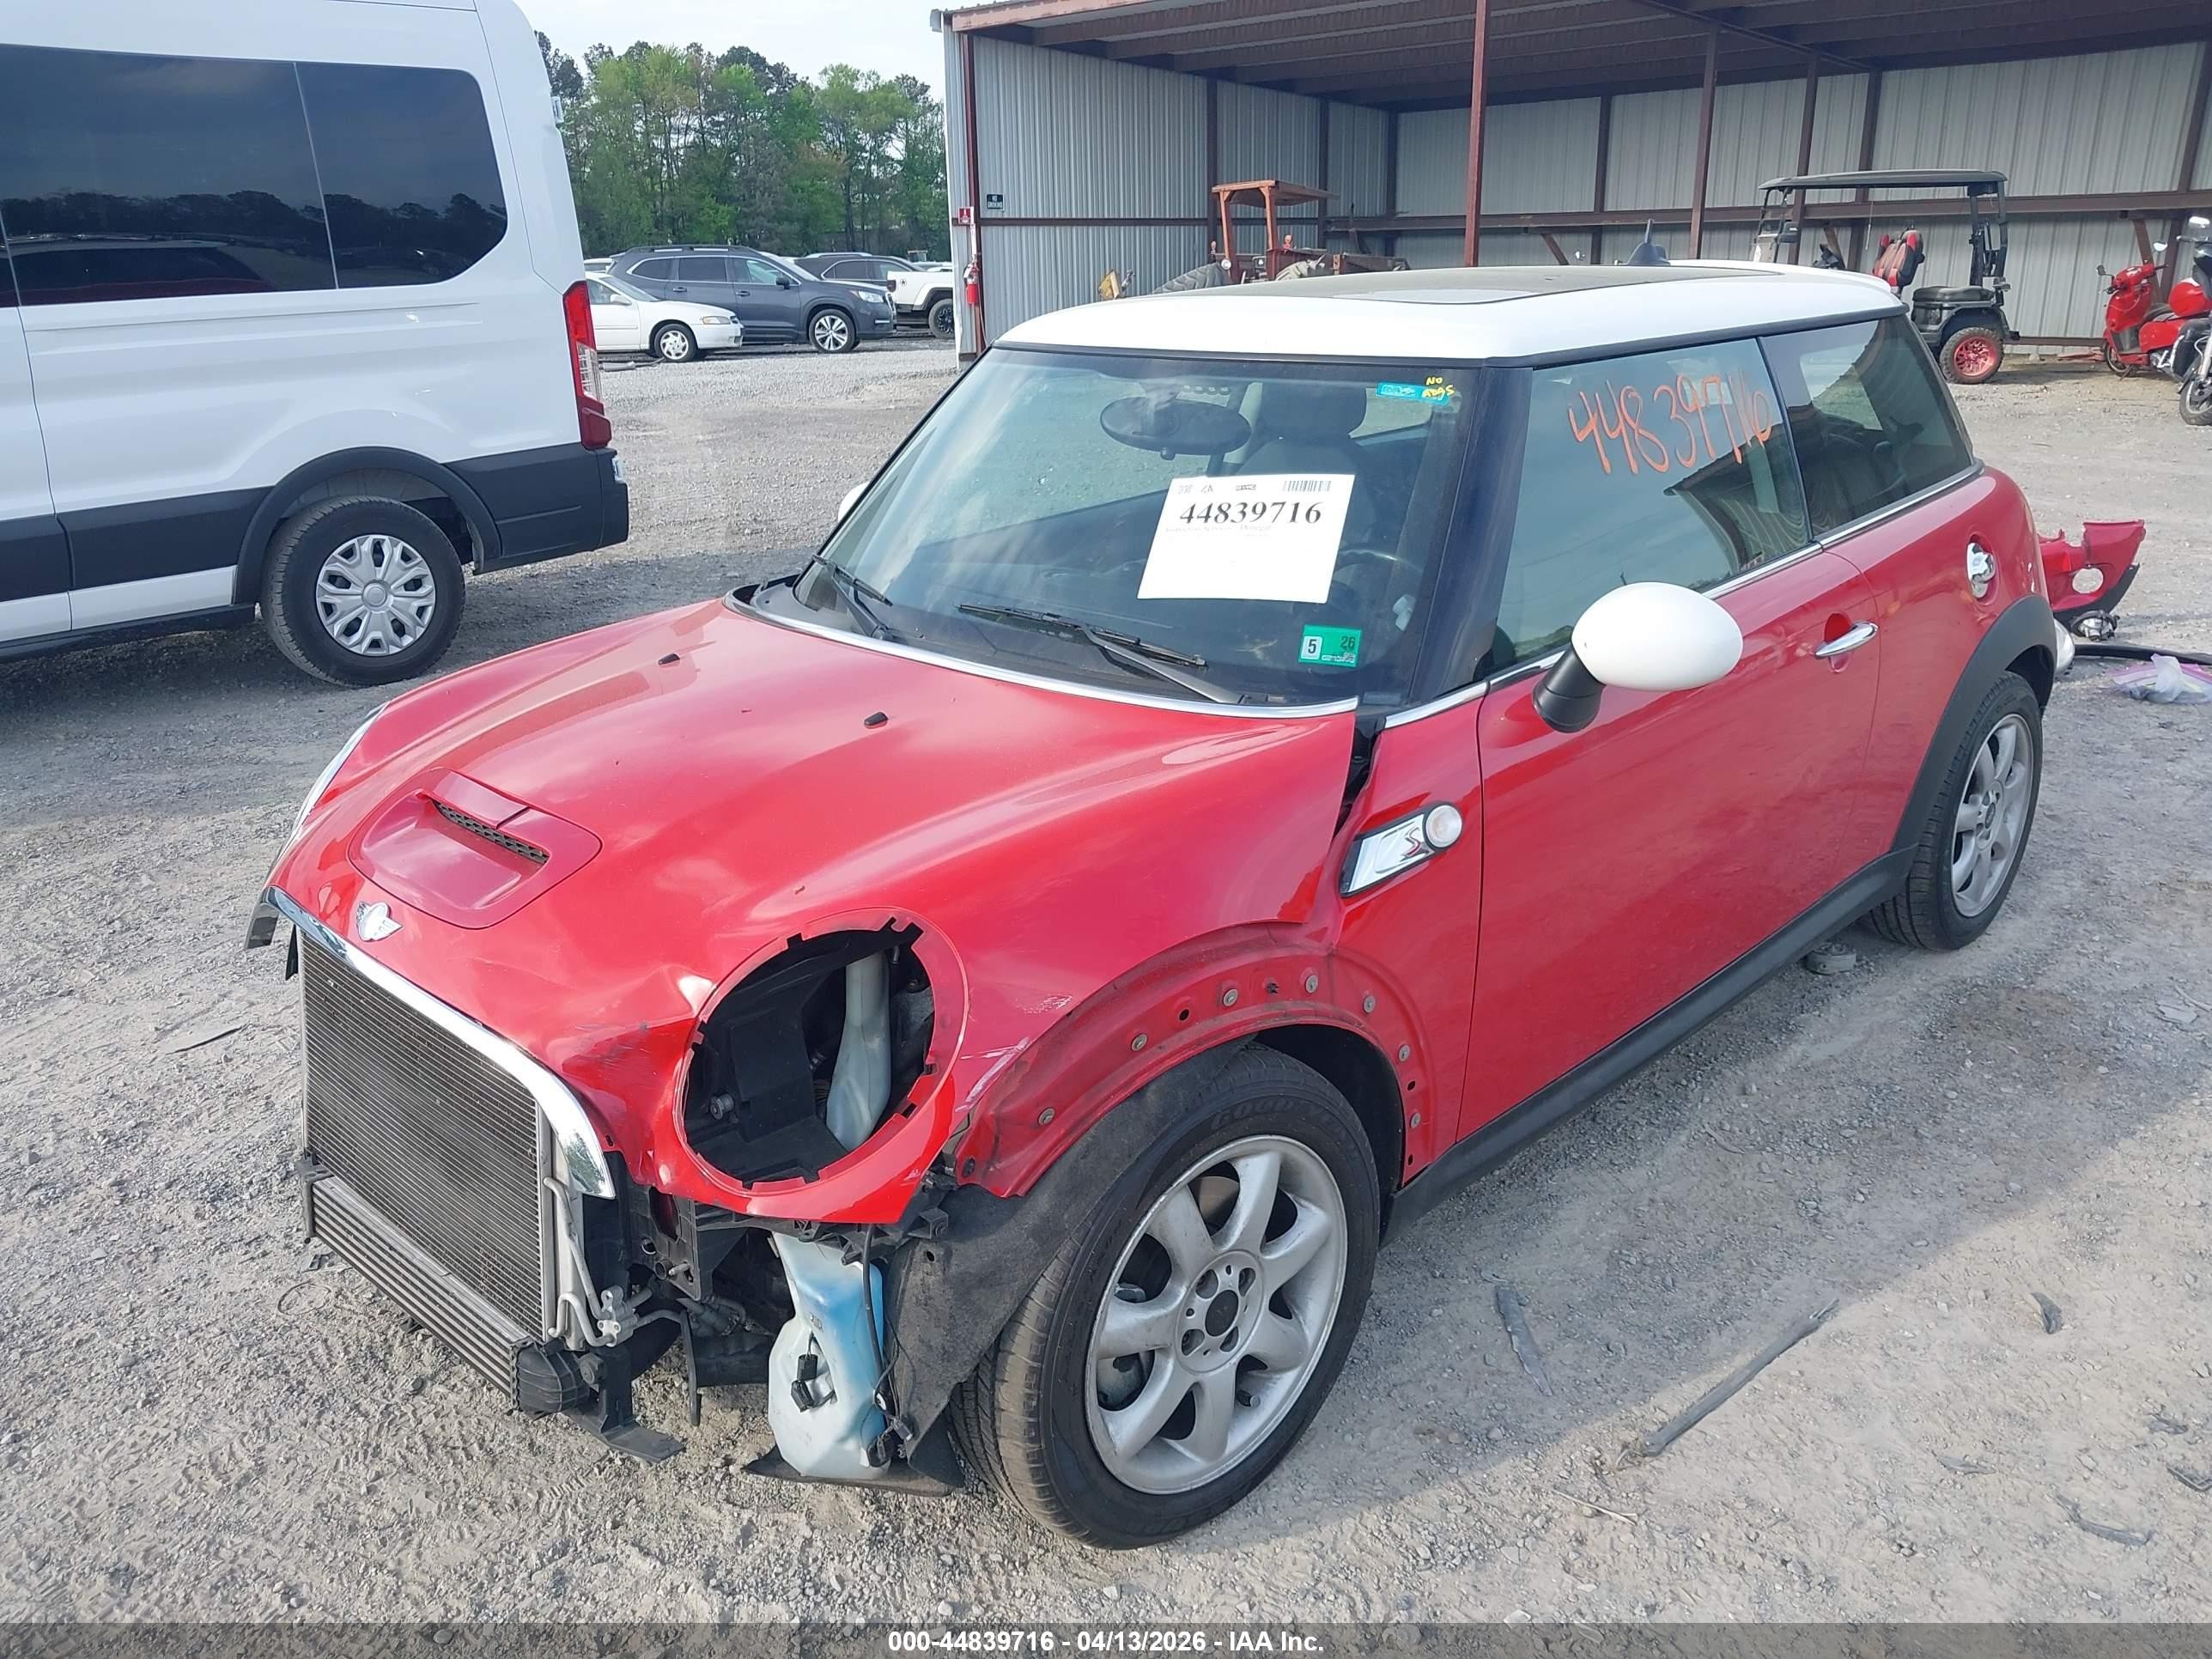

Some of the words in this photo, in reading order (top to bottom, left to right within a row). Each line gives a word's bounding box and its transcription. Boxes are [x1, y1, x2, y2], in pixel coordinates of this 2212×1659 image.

[1425, 376, 1443, 386] NO
[1567, 368, 1772, 474] 44839716
[1179, 501, 1323, 524] 44839716
[1308, 638, 1318, 654] 5
[1340, 635, 1357, 649] 26
